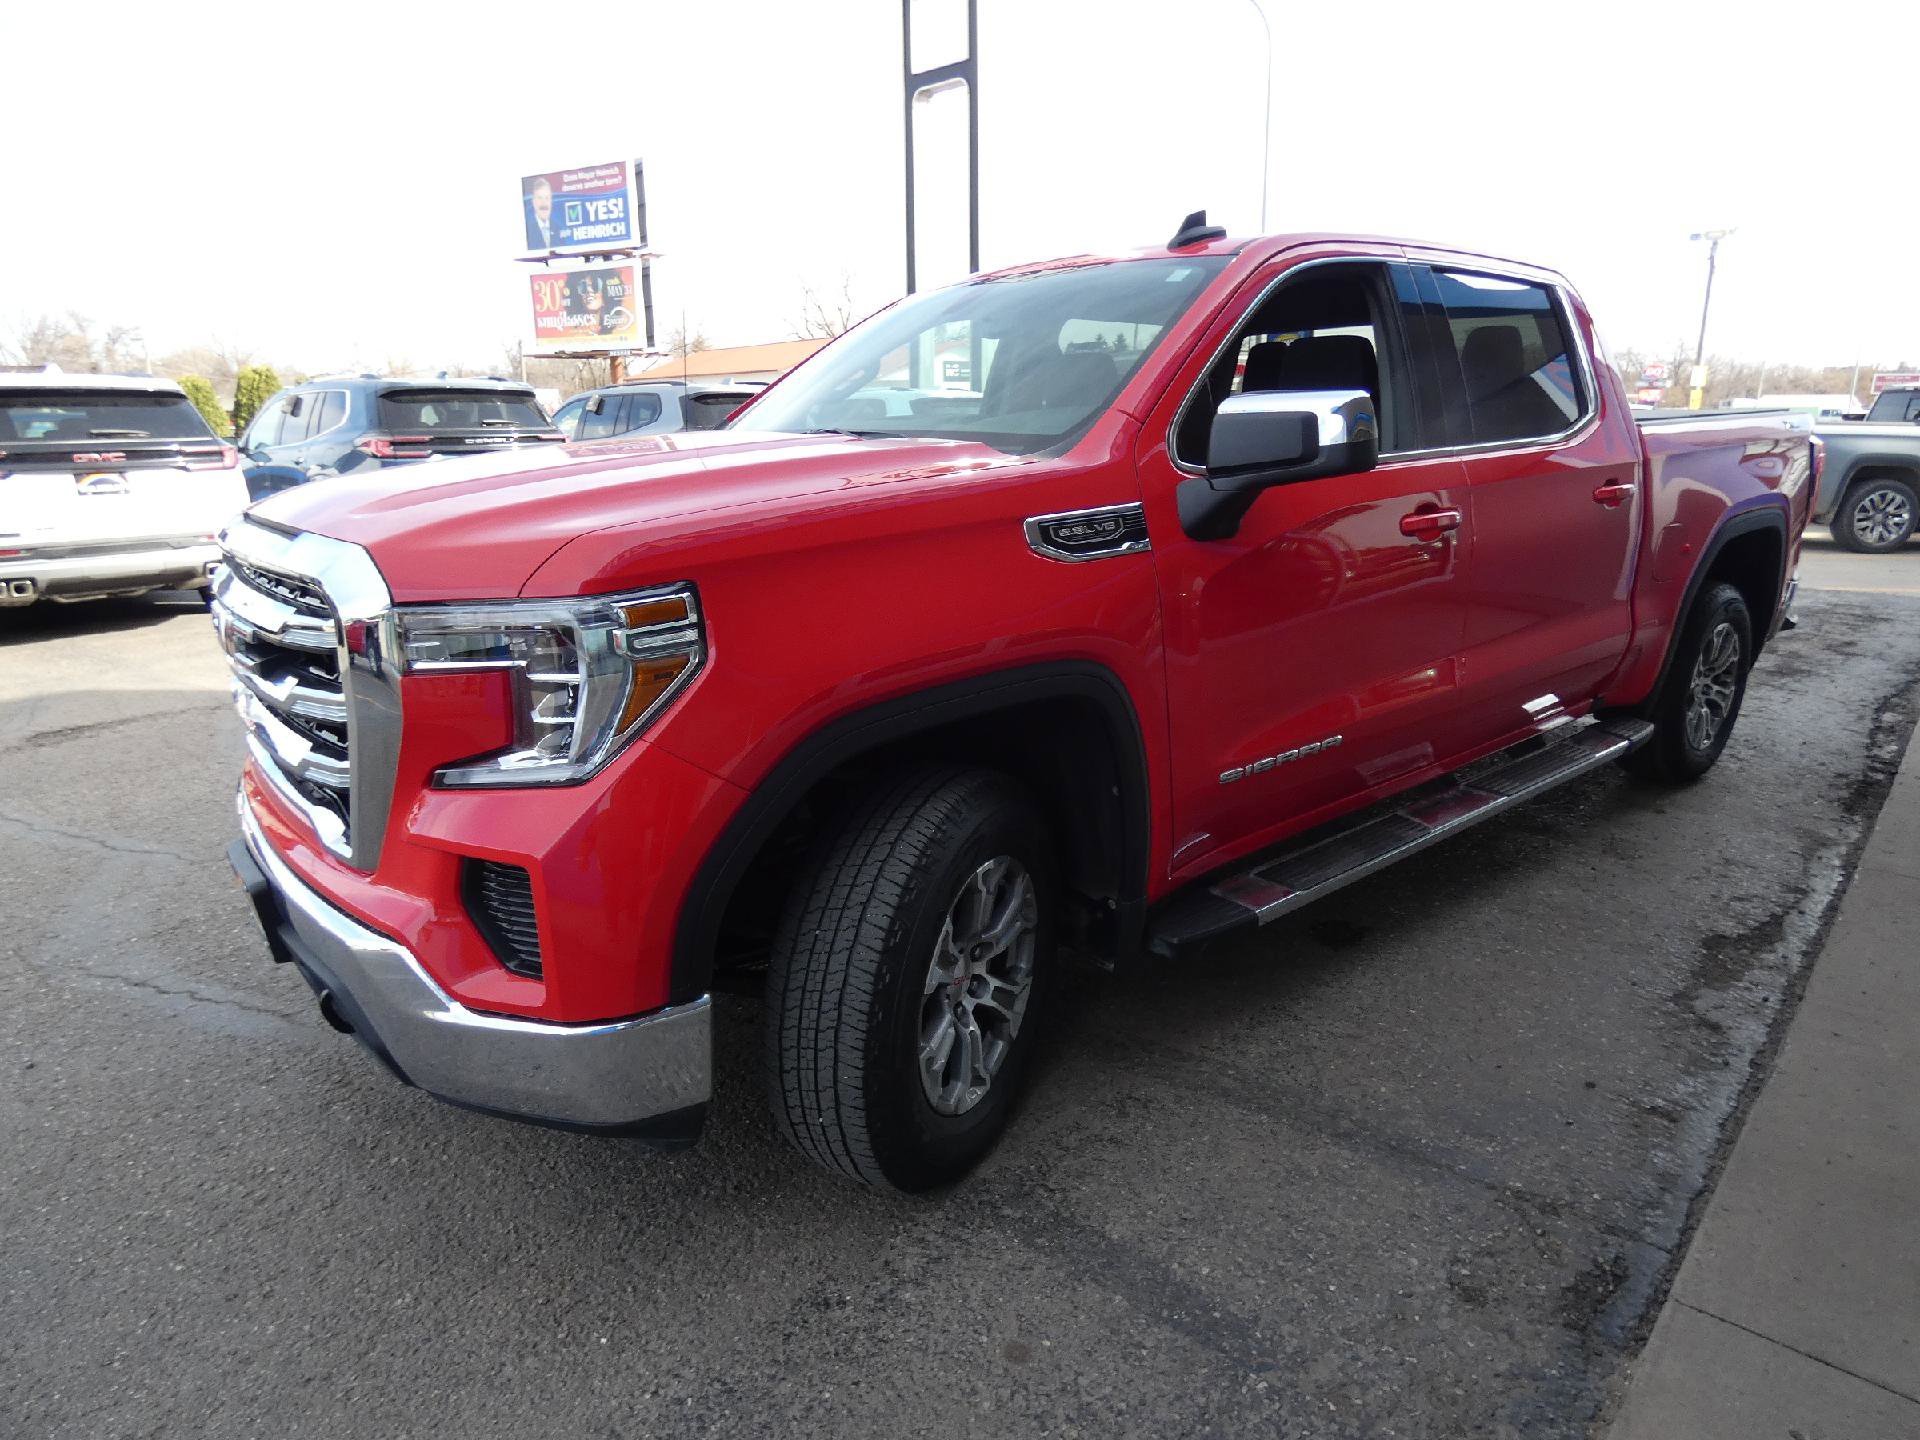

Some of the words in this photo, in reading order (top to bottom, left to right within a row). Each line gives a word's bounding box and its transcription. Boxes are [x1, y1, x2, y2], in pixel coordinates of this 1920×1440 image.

[585, 198, 624, 222] YES!
[573, 221, 626, 241] HEINRICH
[73, 453, 126, 462] GMC
[1218, 733, 1343, 784] SIERRA
